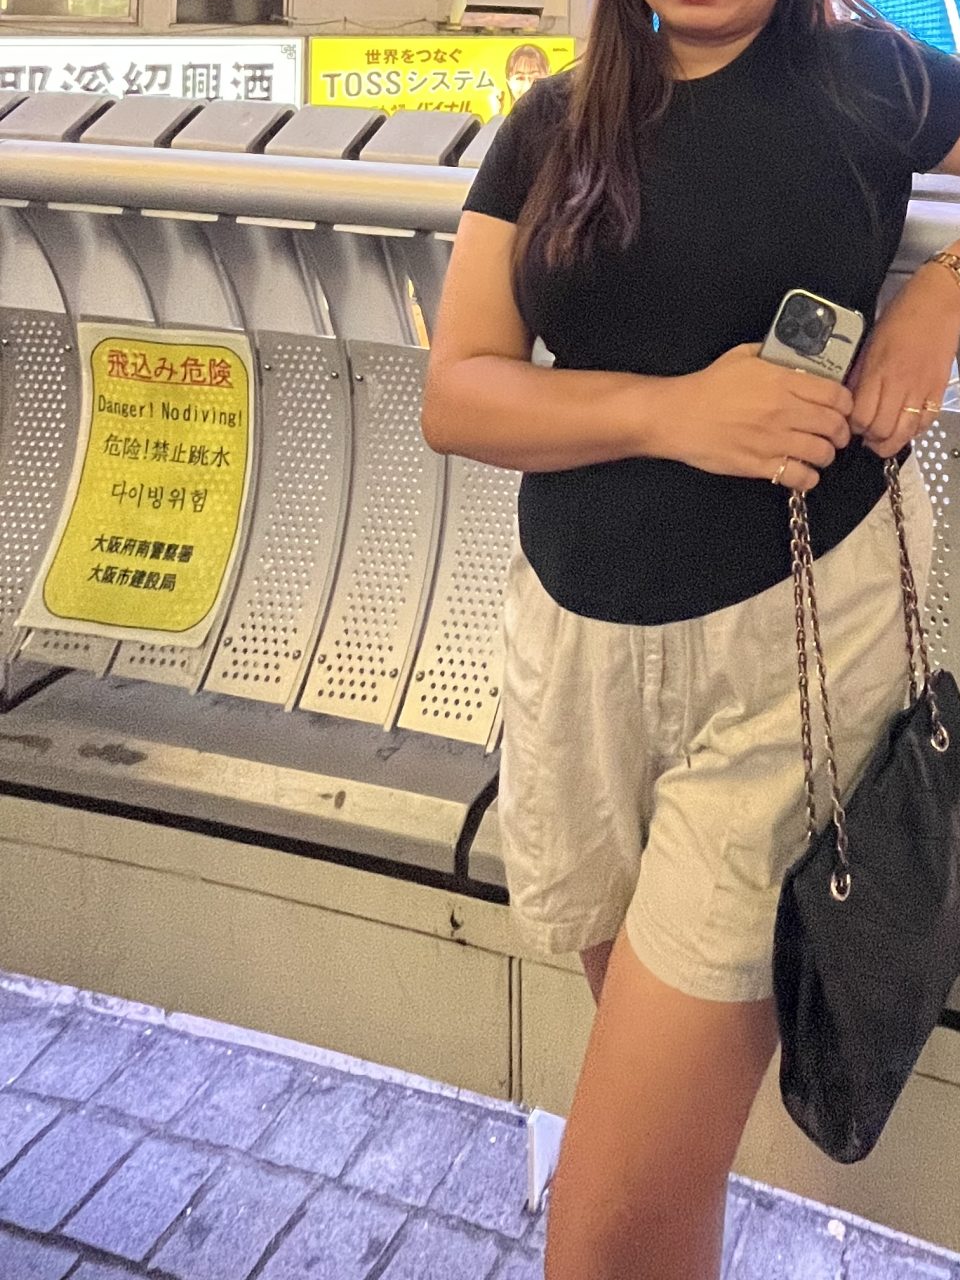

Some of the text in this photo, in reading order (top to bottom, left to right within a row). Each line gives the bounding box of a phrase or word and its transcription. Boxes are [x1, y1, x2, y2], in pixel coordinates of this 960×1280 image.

[365, 48, 462, 65] 世界をつなぐ
[322, 70, 495, 98] TOSSシステム
[108, 349, 233, 386] 飛込み危険
[98, 394, 153, 418] Danger!
